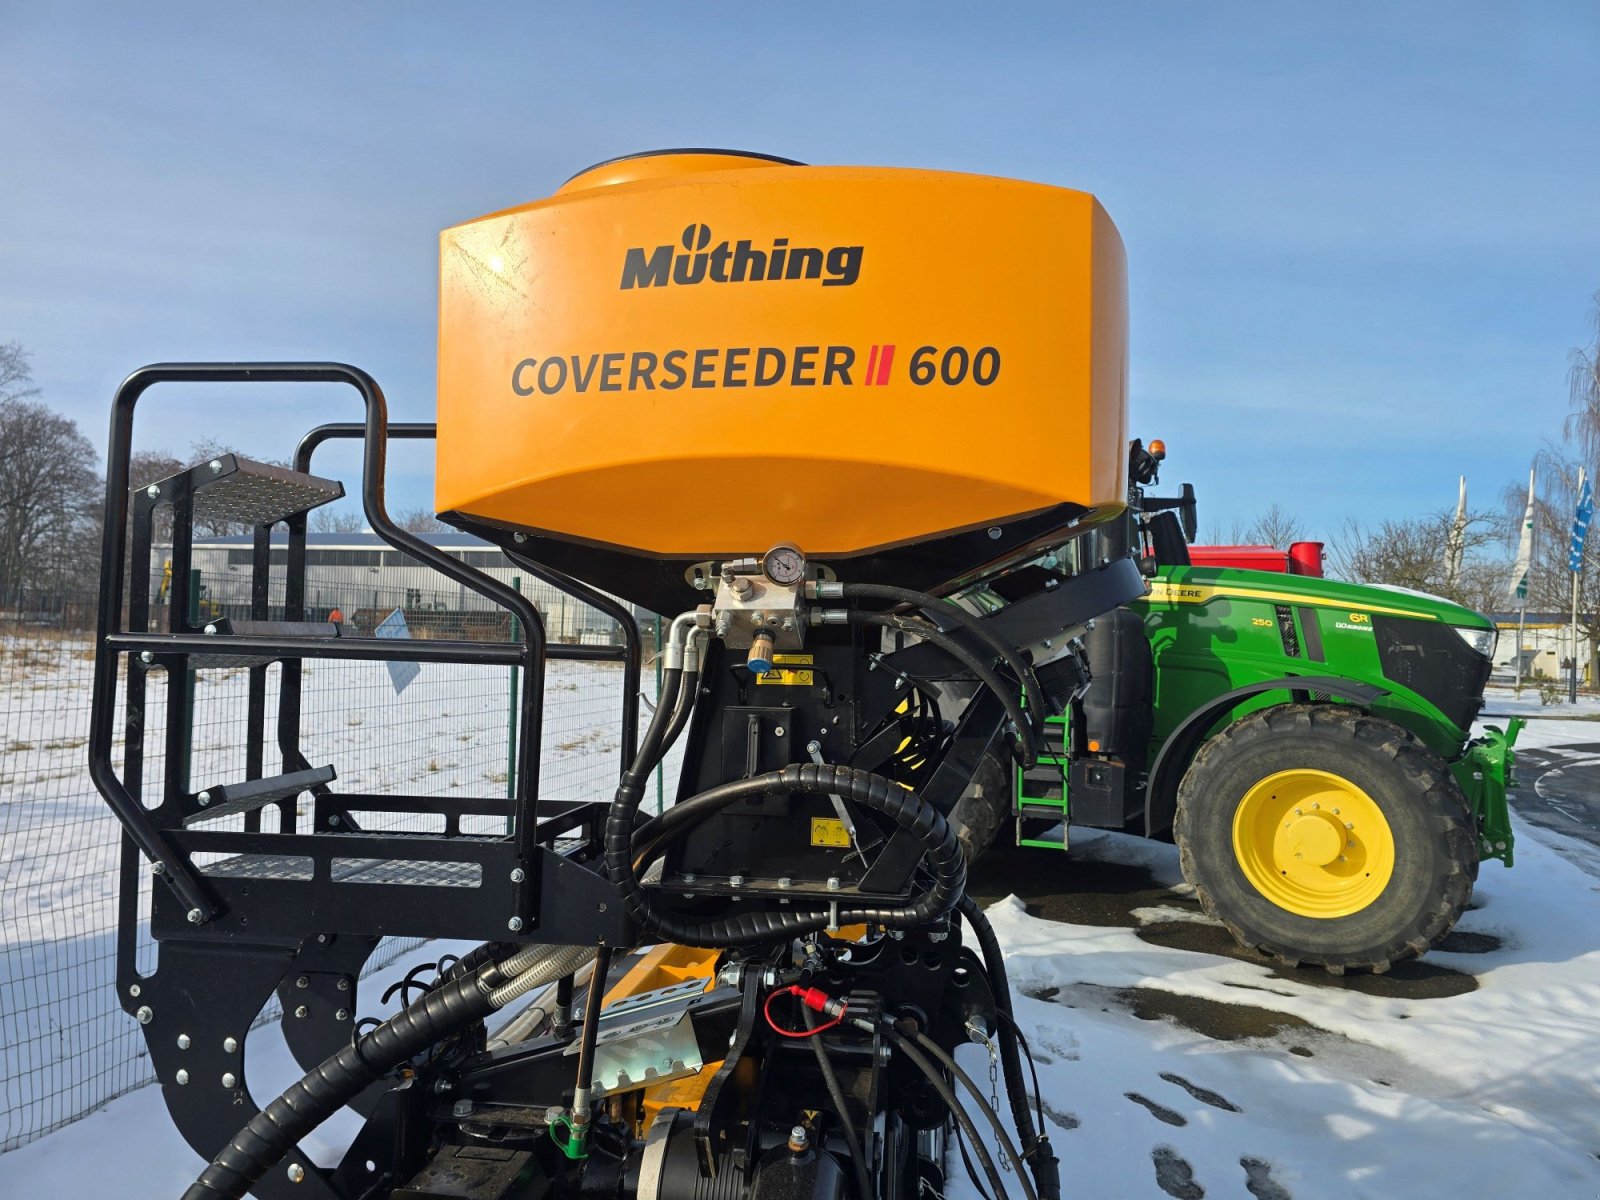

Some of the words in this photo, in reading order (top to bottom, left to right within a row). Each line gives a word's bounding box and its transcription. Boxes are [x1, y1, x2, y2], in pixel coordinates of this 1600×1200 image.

[511, 346, 856, 397] COVERSEEDER
[909, 346, 1001, 387] 600
[1251, 618, 1273, 627] 250
[1349, 613, 1369, 623] 6R
